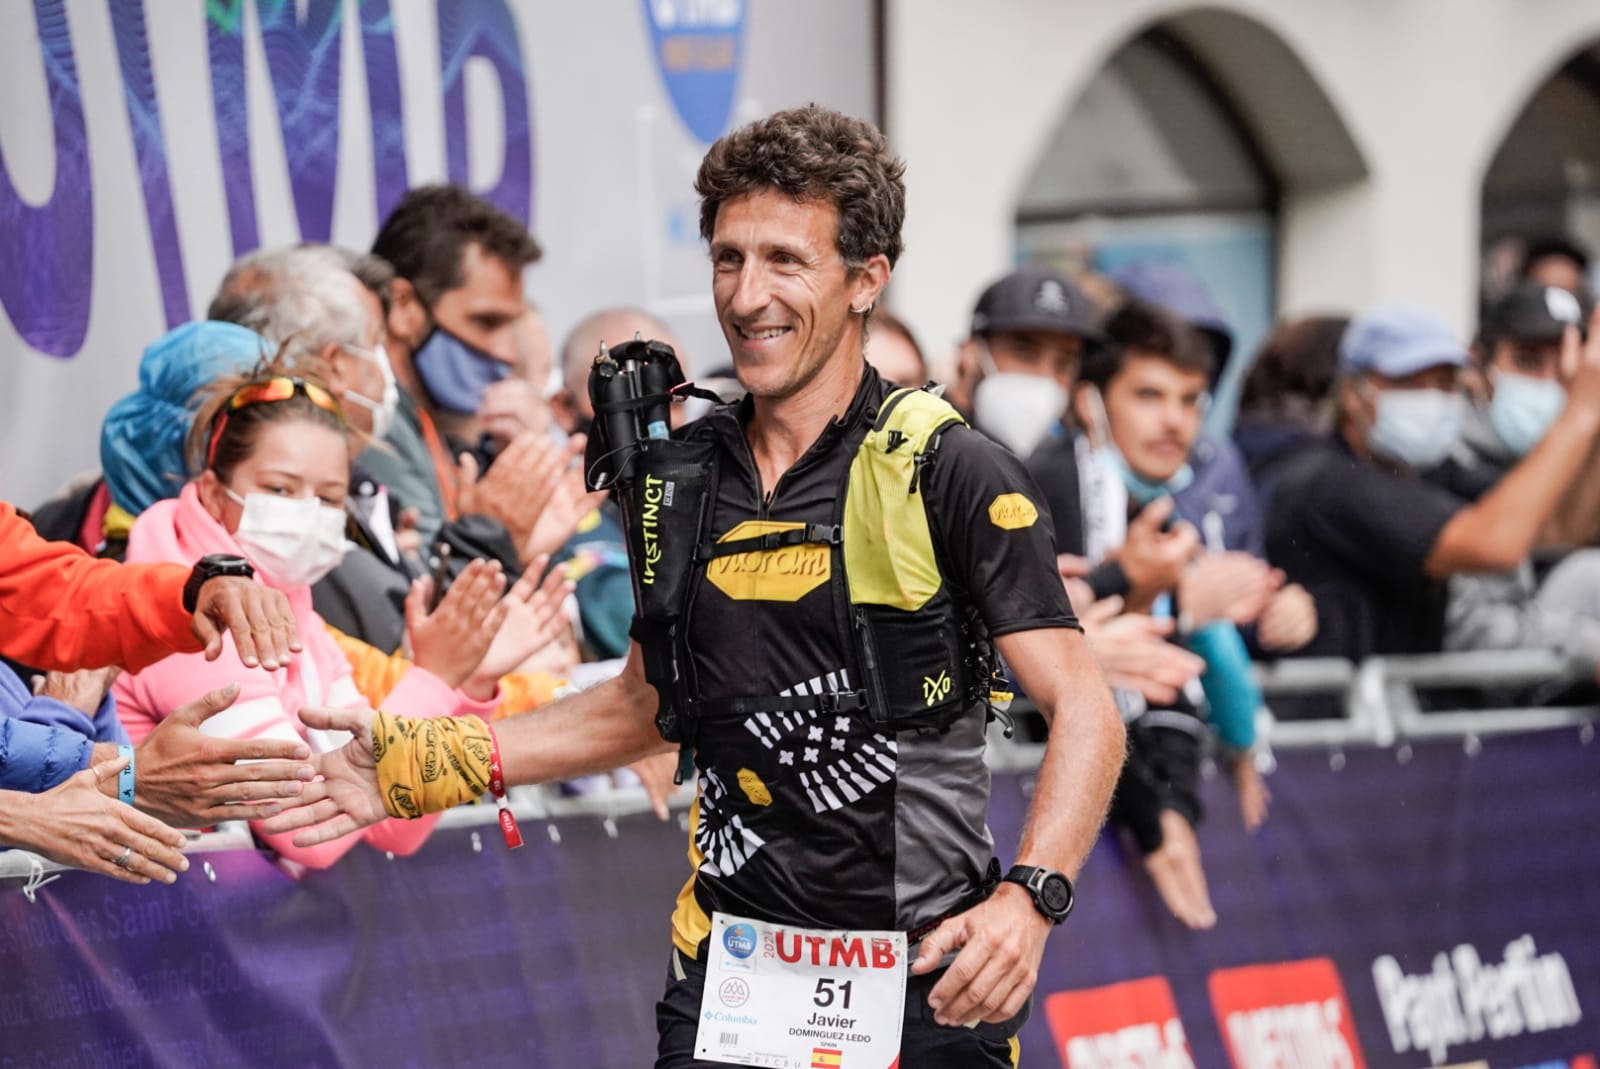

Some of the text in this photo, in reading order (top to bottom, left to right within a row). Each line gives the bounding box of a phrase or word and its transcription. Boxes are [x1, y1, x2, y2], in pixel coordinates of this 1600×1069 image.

[775, 930, 897, 969] UTMB
[813, 977, 852, 1009] 51
[713, 1012, 758, 1025] Columbia
[807, 1012, 857, 1029] Javier
[788, 1027, 872, 1043] DOMINGUEZ LEDO
